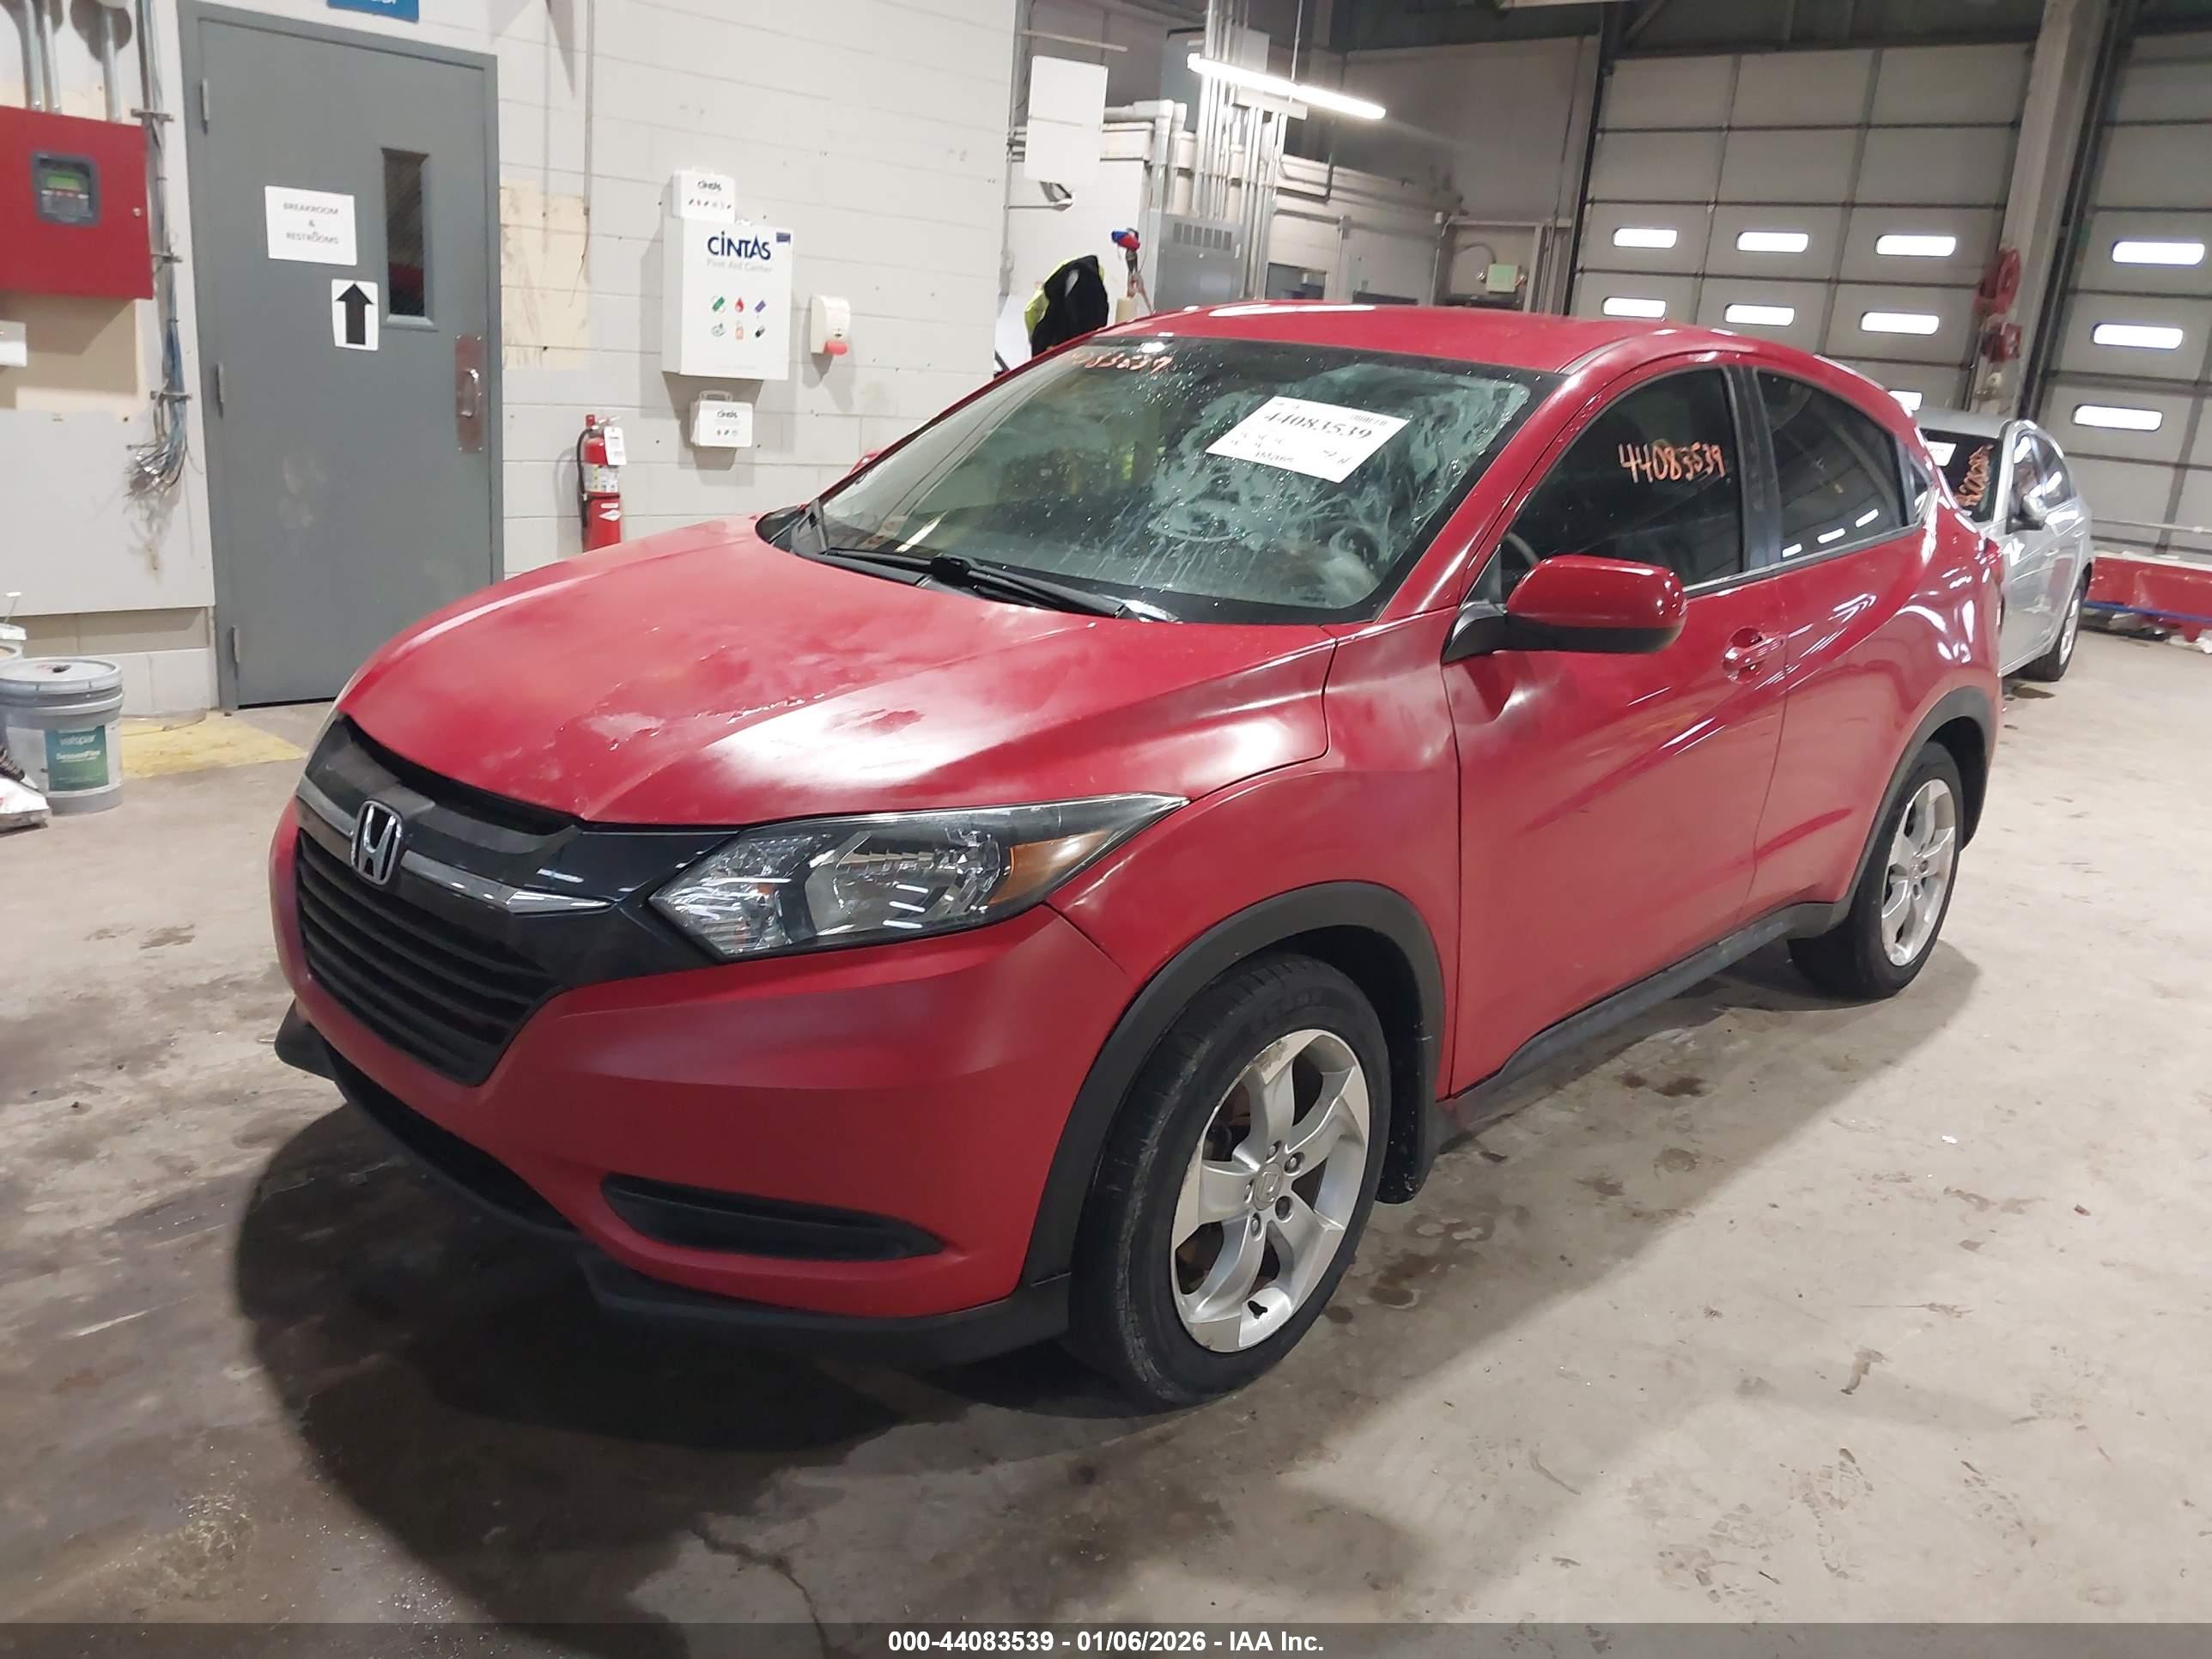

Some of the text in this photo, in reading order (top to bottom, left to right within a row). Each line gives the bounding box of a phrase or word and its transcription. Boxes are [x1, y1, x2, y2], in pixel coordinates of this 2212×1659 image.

[283, 203, 338, 215] BREAKROOM
[286, 231, 339, 245] RESTROOMS
[1264, 411, 1373, 440] 44083539
[1618, 440, 1725, 483] 44083539
